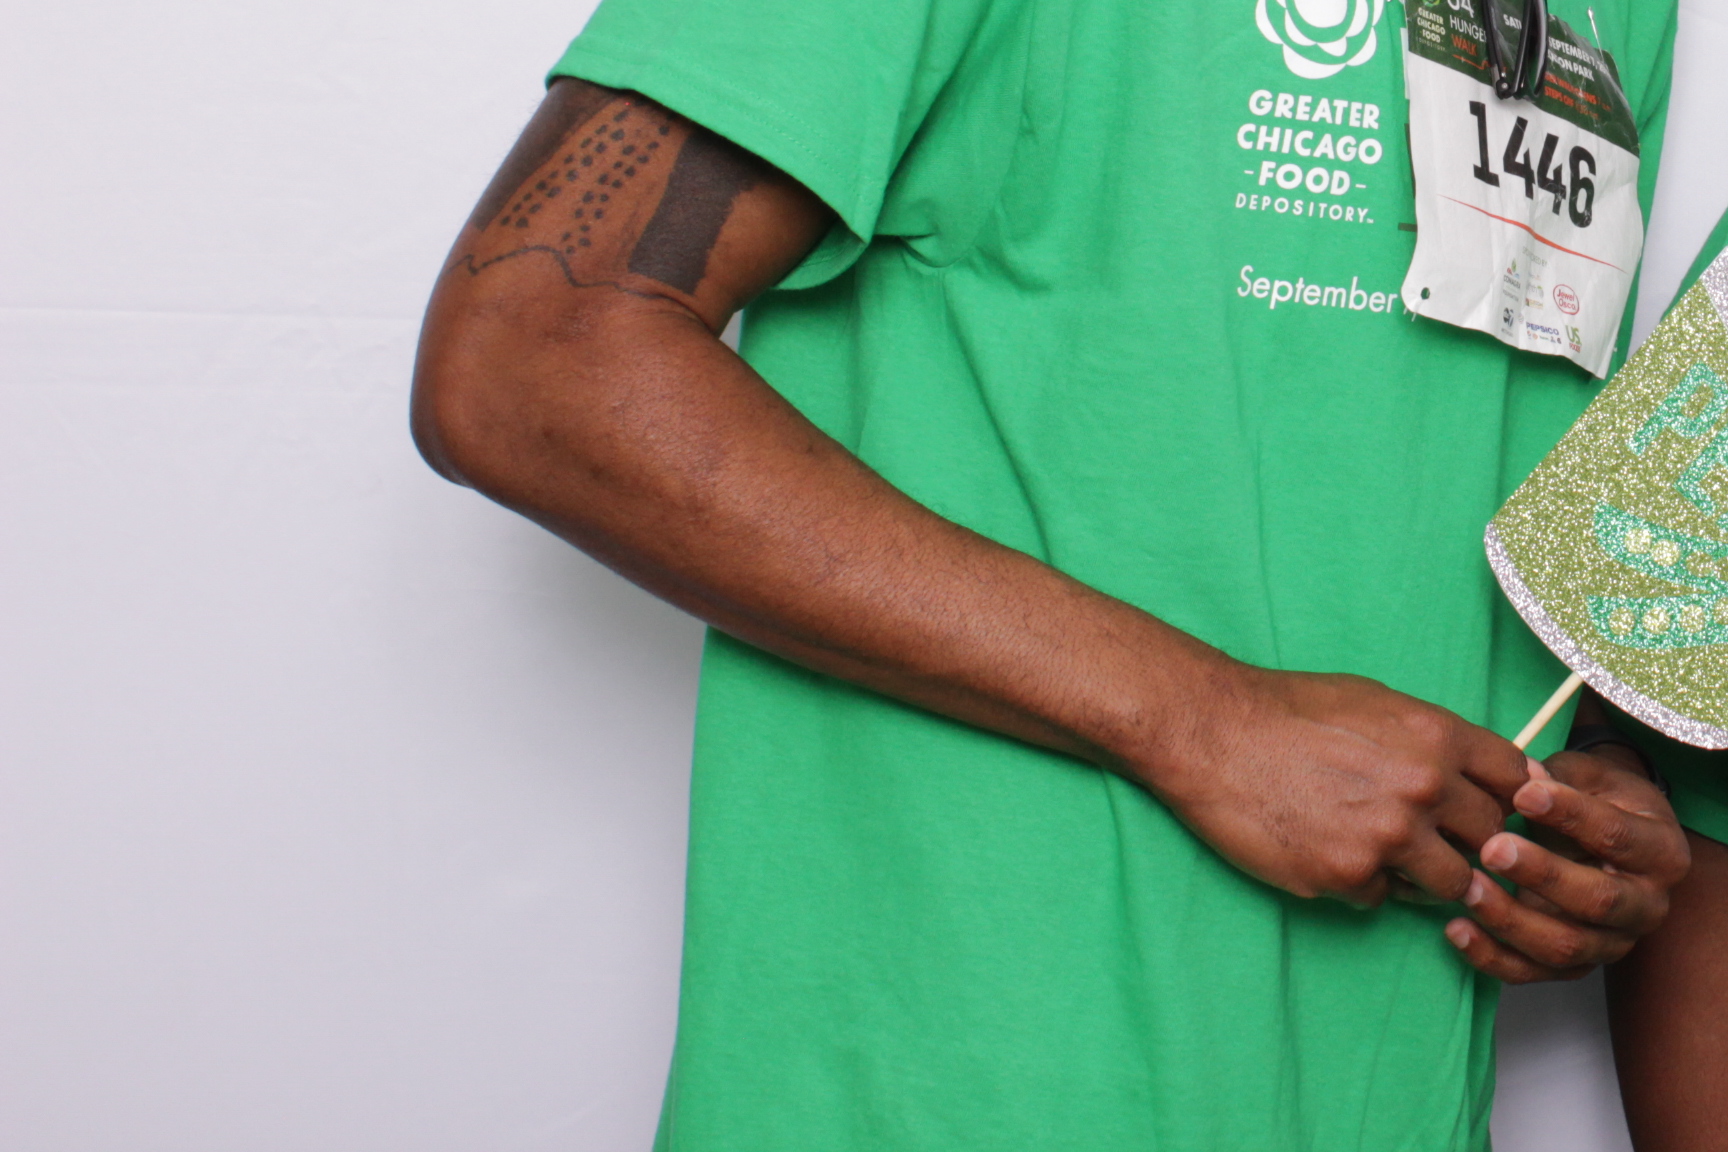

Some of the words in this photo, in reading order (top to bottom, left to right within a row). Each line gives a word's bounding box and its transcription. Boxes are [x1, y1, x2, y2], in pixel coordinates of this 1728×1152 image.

[1417, 17, 1446, 36] CHICAGO
[1422, 29, 1441, 43] FOOD
[1451, 34, 1478, 57] WALK
[1573, 62, 1595, 81] PARK
[1248, 89, 1380, 130] GREATER
[1236, 123, 1383, 165] CHICAGO
[1469, 100, 1597, 229] 1446
[1258, 160, 1351, 196] FOOD
[1237, 265, 1398, 313] September
[1557, 289, 1575, 301] Jewel
[1526, 321, 1559, 336] PEPSICO
